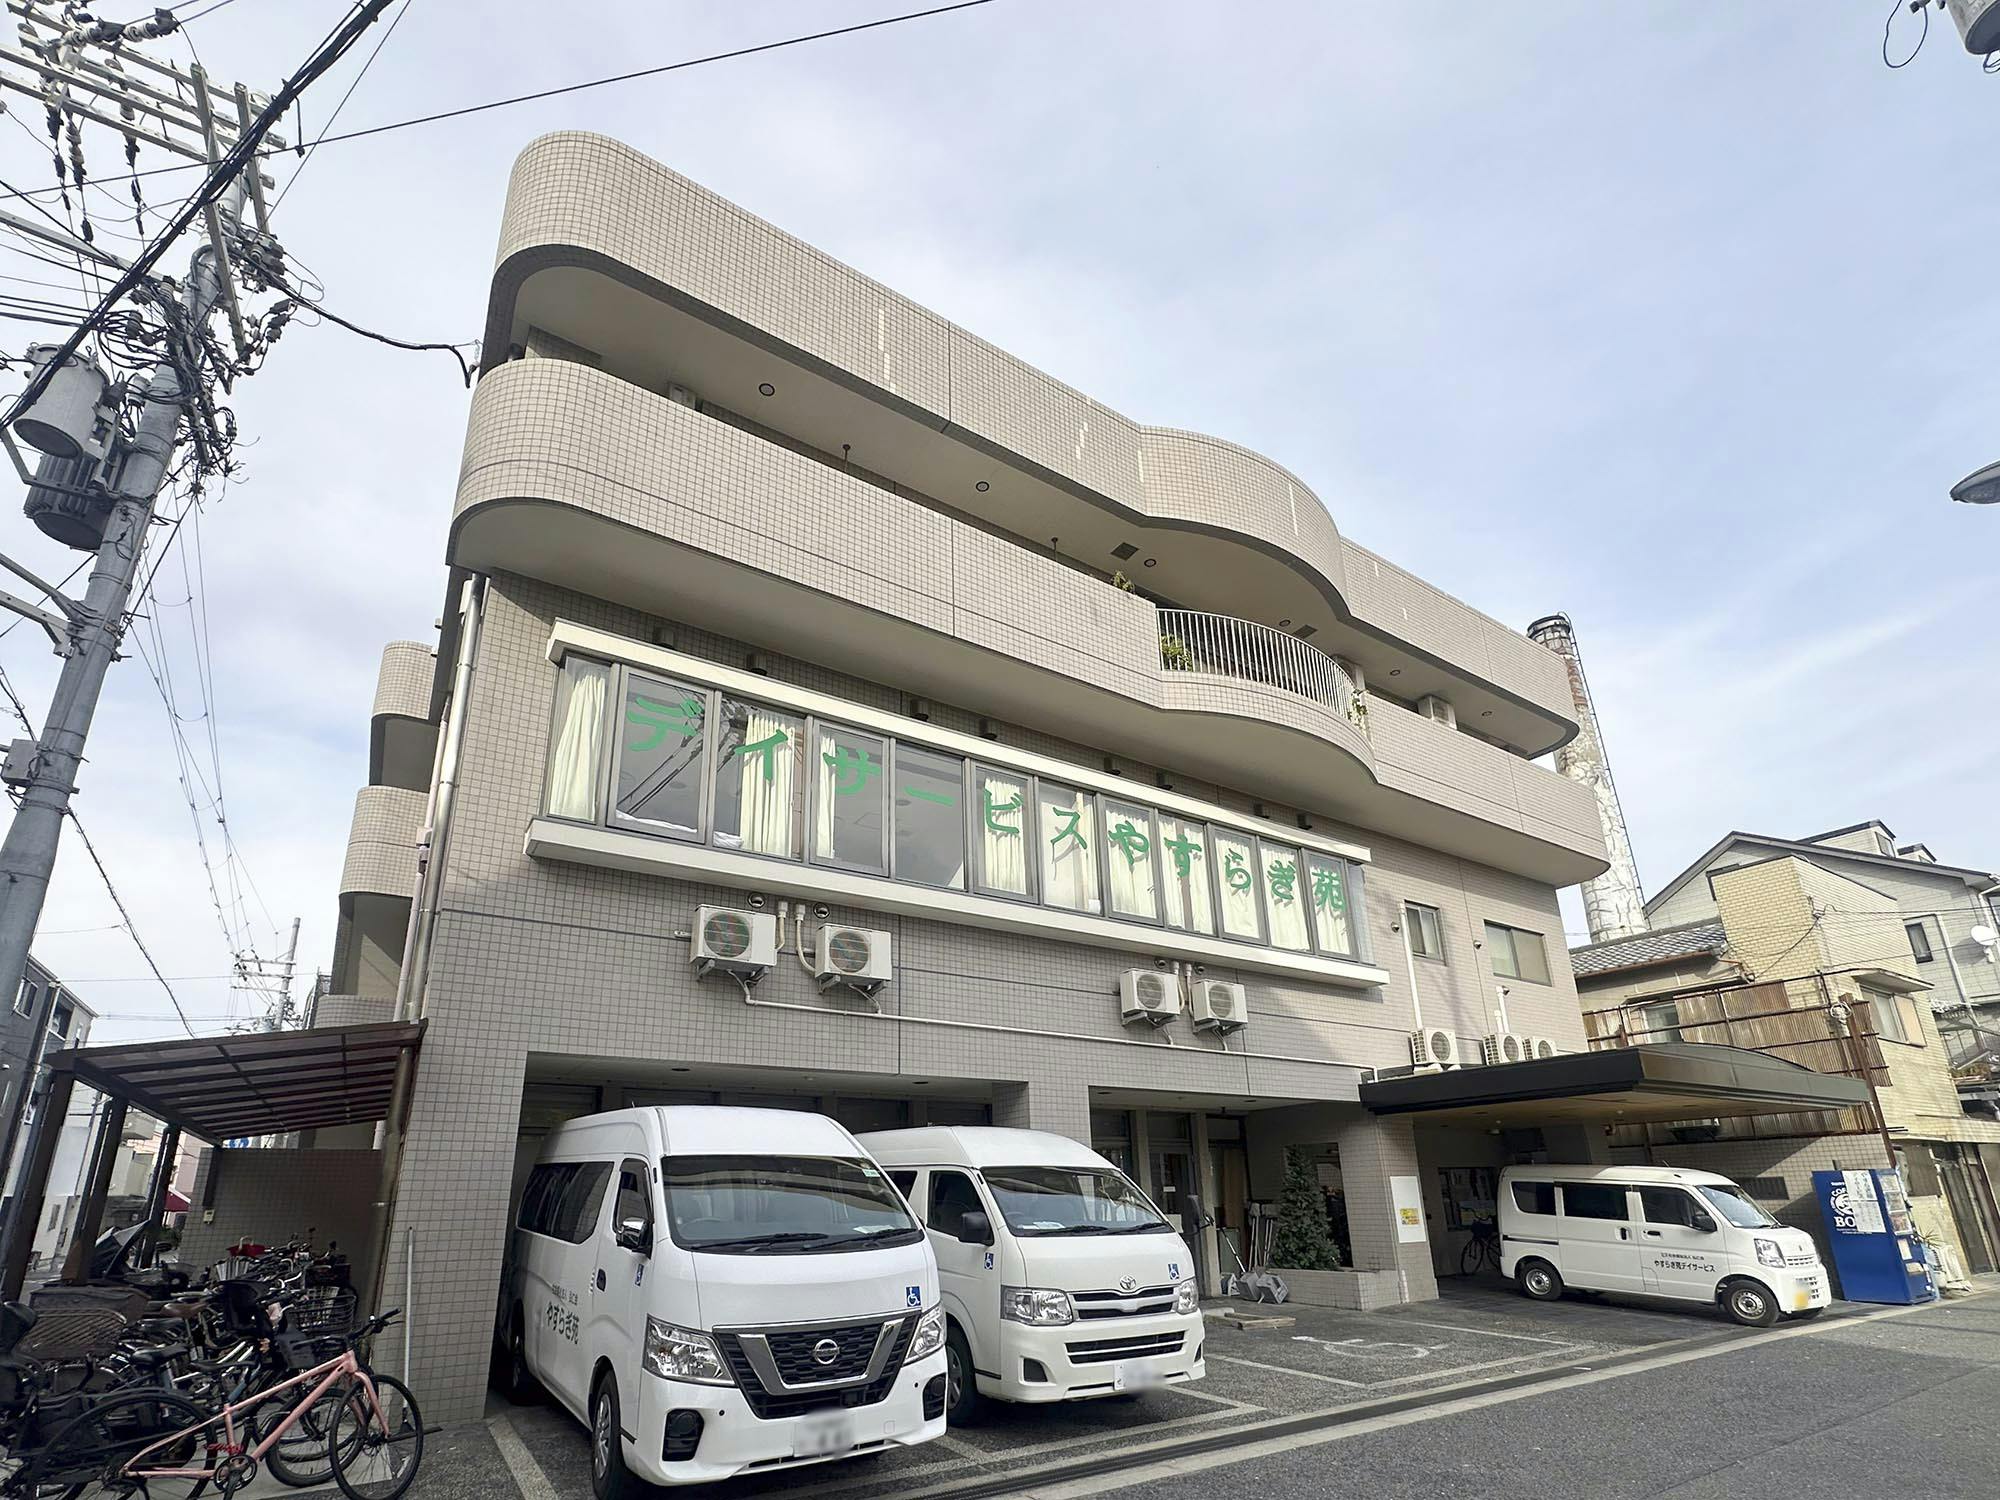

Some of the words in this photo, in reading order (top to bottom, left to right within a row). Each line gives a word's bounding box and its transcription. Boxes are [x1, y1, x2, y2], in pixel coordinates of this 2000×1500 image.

[627, 696, 1347, 912] デイサービスやすらぎ苑
[1834, 1216, 1856, 1228] BO
